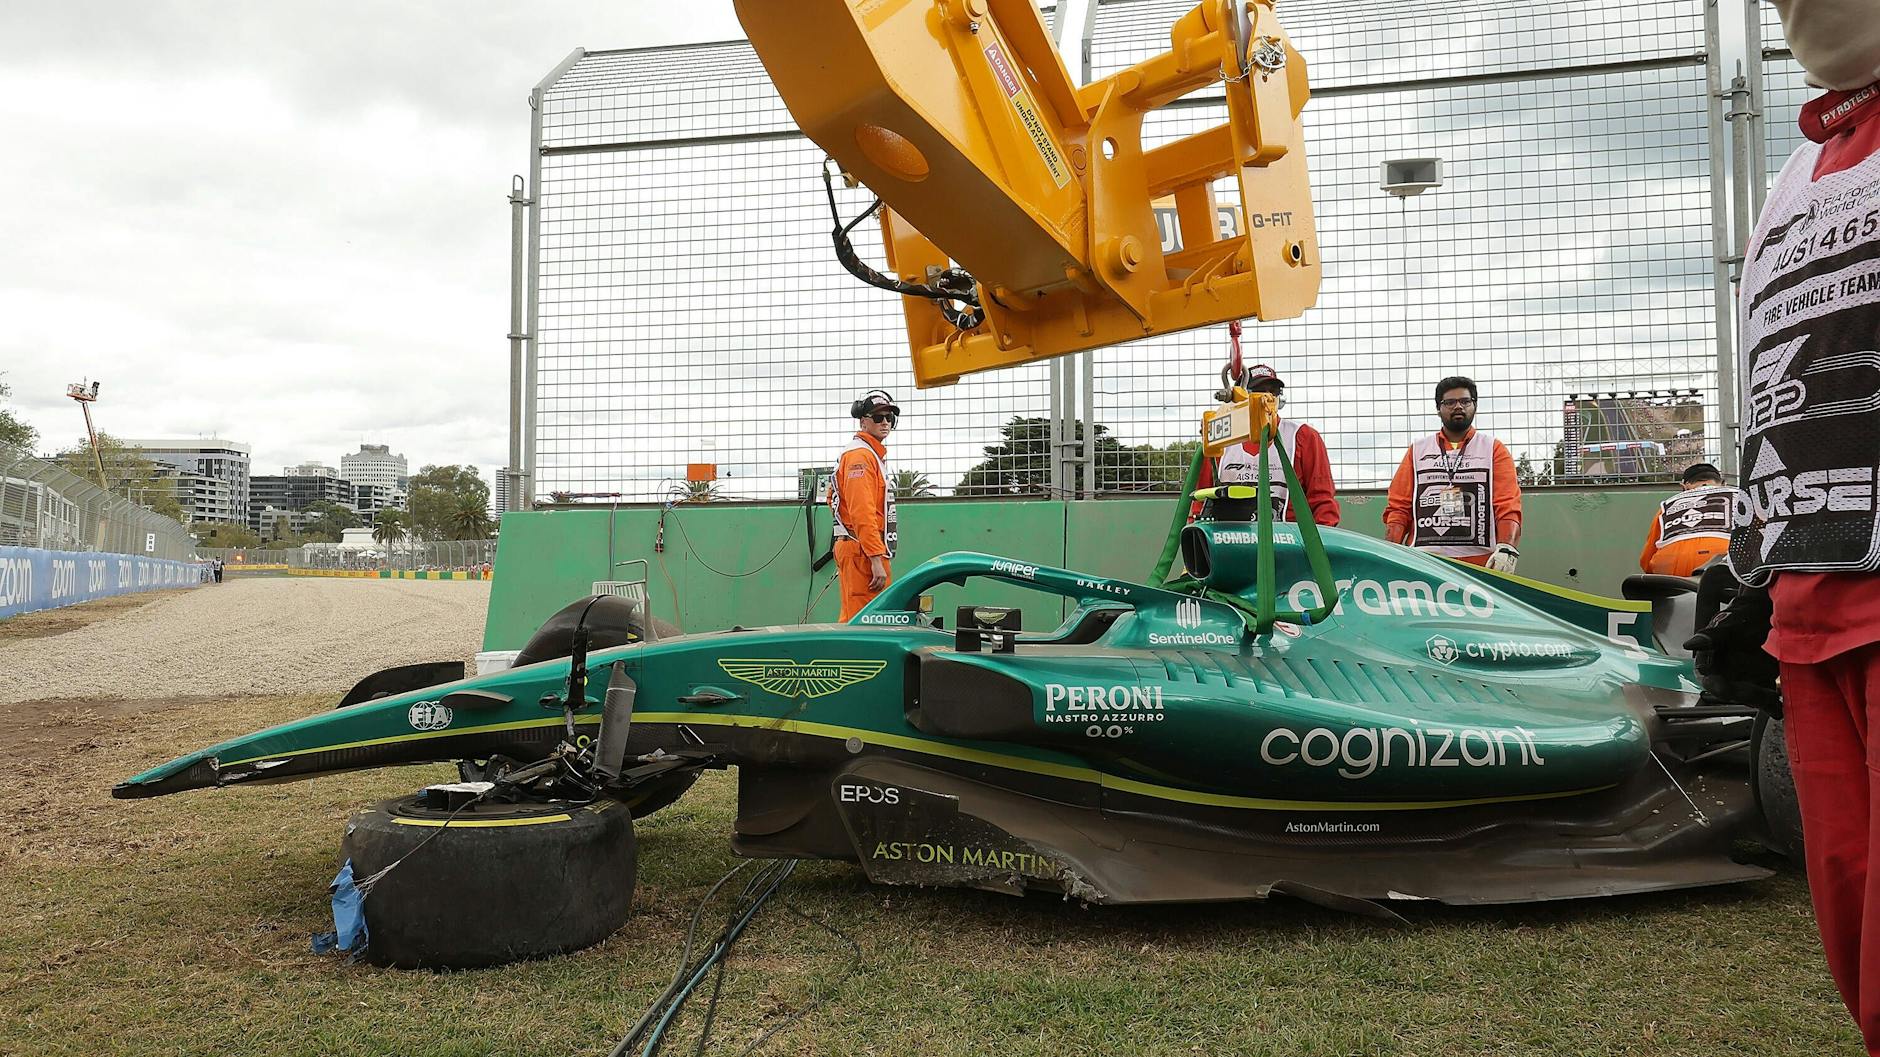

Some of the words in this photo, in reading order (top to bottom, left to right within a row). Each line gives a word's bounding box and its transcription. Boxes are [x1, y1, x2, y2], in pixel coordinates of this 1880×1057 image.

[995, 58, 1017, 94] DANGER
[1821, 85, 1878, 124] PYROTECT
[1015, 101, 1033, 128] UNDER
[1031, 128, 1060, 178] ATTACHMENT
[1026, 109, 1035, 121] DO
[1034, 121, 1044, 136] NOT
[1043, 137, 1058, 163] STAND
[1252, 211, 1293, 228] Q-FIT
[1769, 209, 1879, 278] AUS1465
[1763, 304, 1783, 328] FIRE
[1785, 284, 1836, 316] VEHICLE
[1840, 270, 1880, 298] TEAM
[1208, 414, 1231, 442] JCB
[1417, 516, 1471, 528] COURSE
[1477, 483, 1486, 546] MELBOURNE
[1664, 511, 1725, 530] COURSE
[51, 559, 76, 599] zoom
[88, 559, 106, 593] zoom
[118, 559, 133, 588] zoom
[1077, 579, 1131, 596] OAKLEY
[1288, 576, 1495, 617] aramco
[861, 613, 910, 625] aramco
[1149, 633, 1235, 645] SentinelOne
[1608, 612, 1649, 660] 5
[1465, 641, 1572, 660] crypto.com
[766, 668, 799, 678] ASTON
[801, 668, 838, 678] MARTIN
[1045, 684, 1165, 712] PERONI
[1046, 713, 1098, 723] NASTRO
[1102, 713, 1165, 722] AZZURRO
[1086, 725, 1134, 739] 0.0%
[1260, 719, 1545, 779] cognizant
[840, 784, 900, 804] EPOS
[1285, 821, 1380, 832] AstonMartin.com
[872, 841, 954, 864] ASTON
[962, 846, 1057, 875] MARTIN
